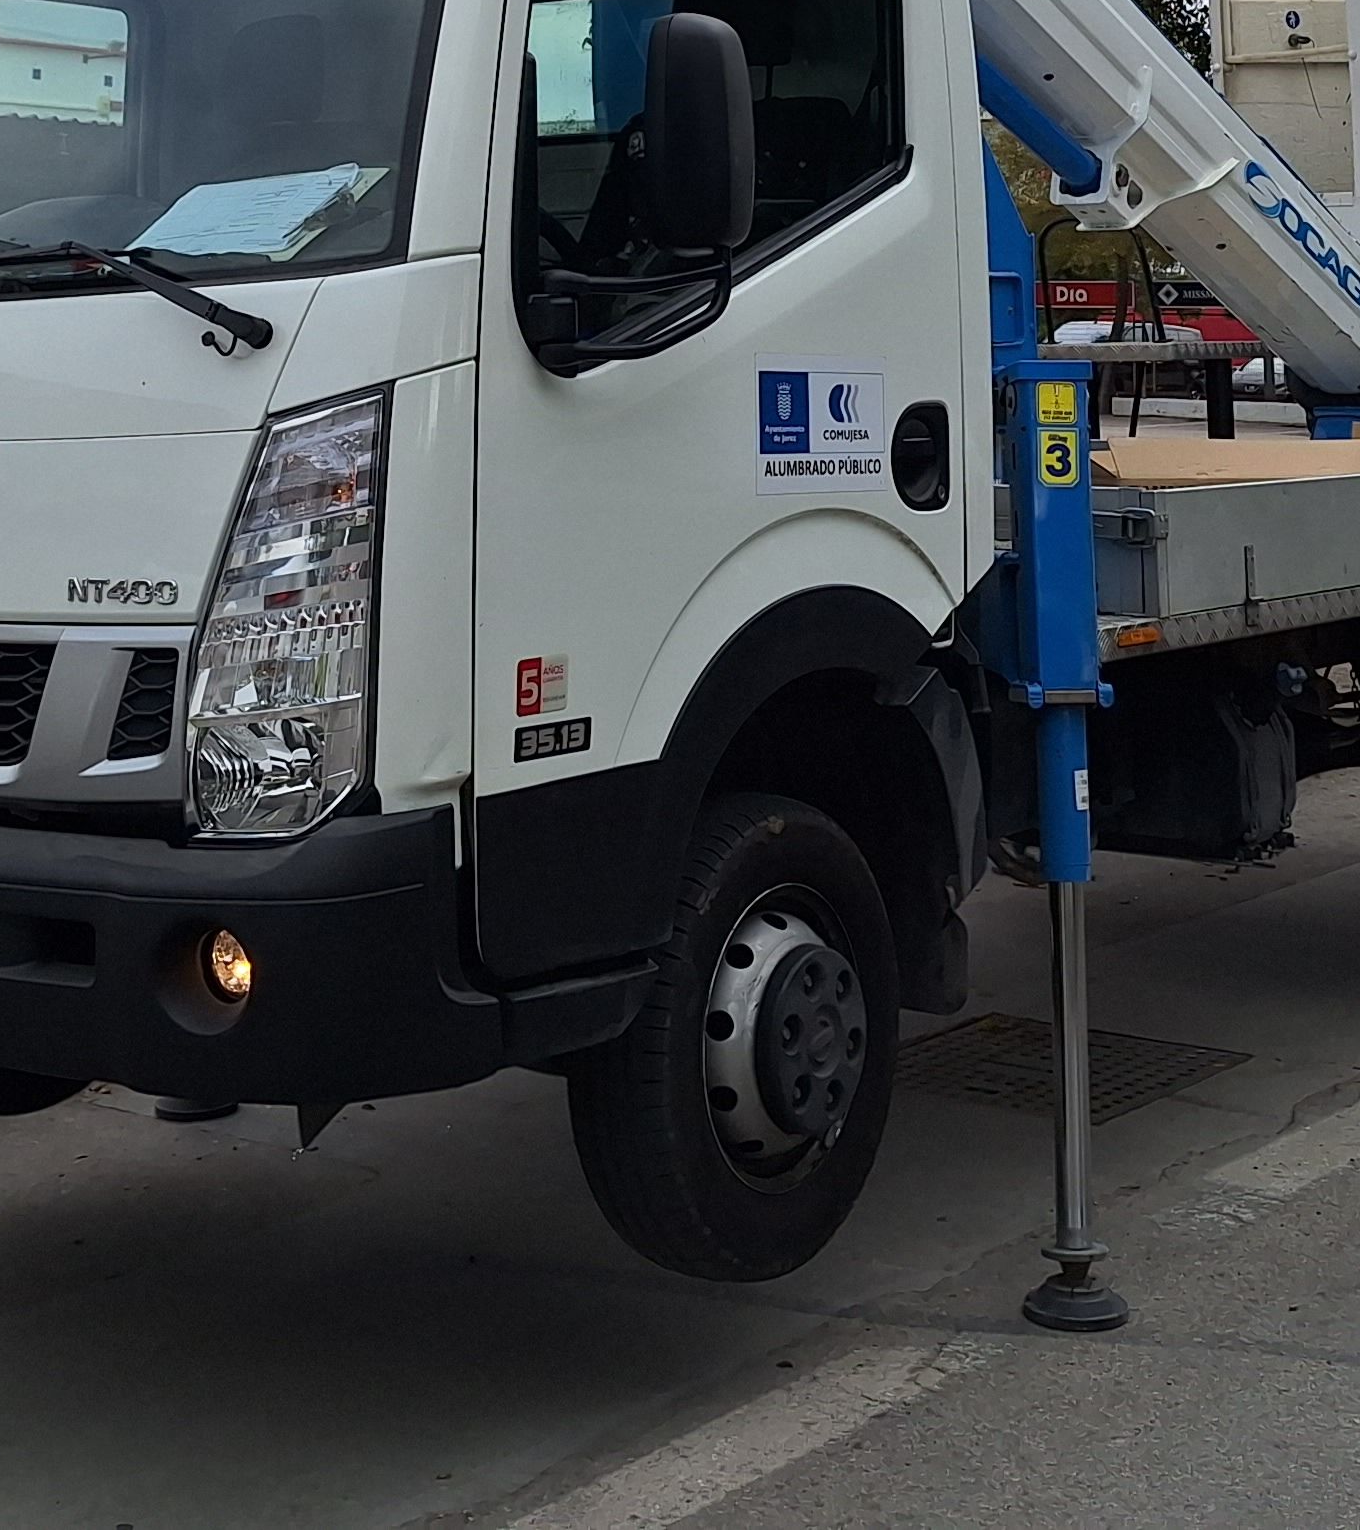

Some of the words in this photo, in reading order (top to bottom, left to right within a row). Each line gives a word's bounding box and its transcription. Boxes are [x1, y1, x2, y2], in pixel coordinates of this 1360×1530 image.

[1055, 285, 1088, 303] Dia
[764, 459, 836, 478] ALUMBRADO
[838, 455, 882, 476] PÚBLICO
[1045, 443, 1073, 478] 3
[67, 576, 180, 606] NT400
[520, 668, 539, 707] 5
[520, 722, 586, 758] 35.13
